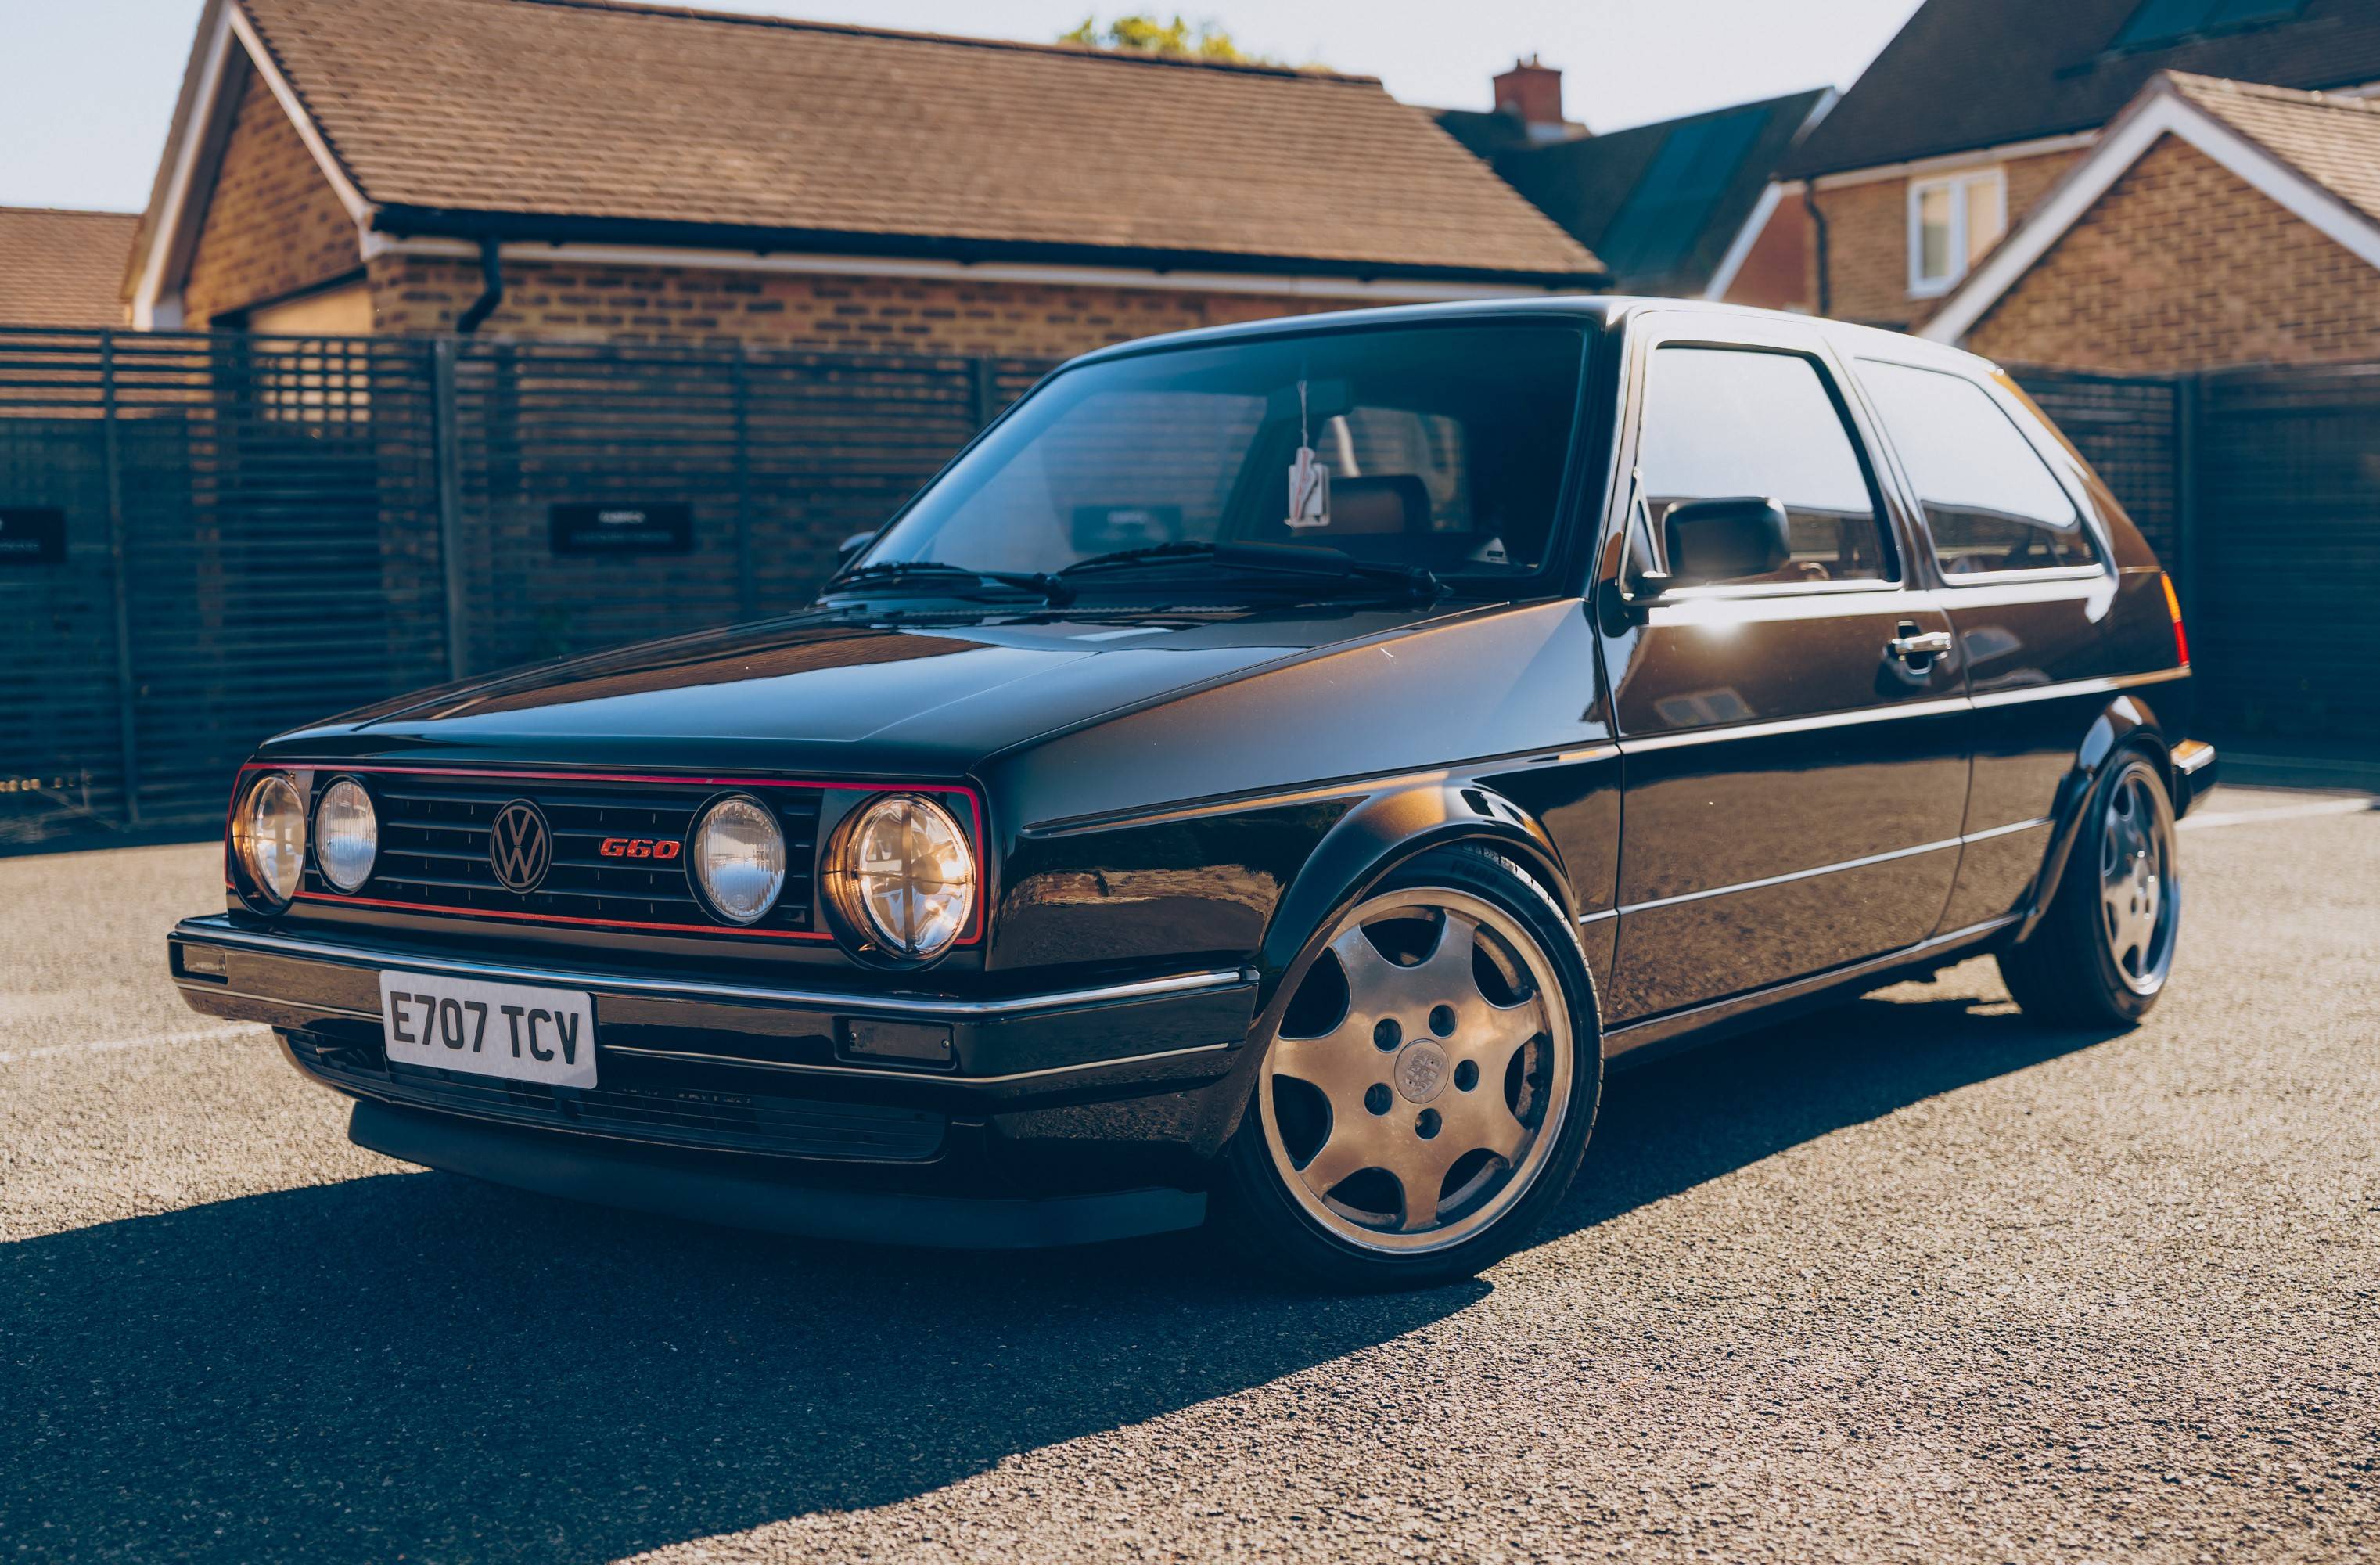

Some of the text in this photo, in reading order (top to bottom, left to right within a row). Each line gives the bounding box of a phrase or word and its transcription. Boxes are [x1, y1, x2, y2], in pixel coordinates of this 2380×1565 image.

[600, 837, 681, 859] G60
[390, 991, 578, 1065] E707 TCV
